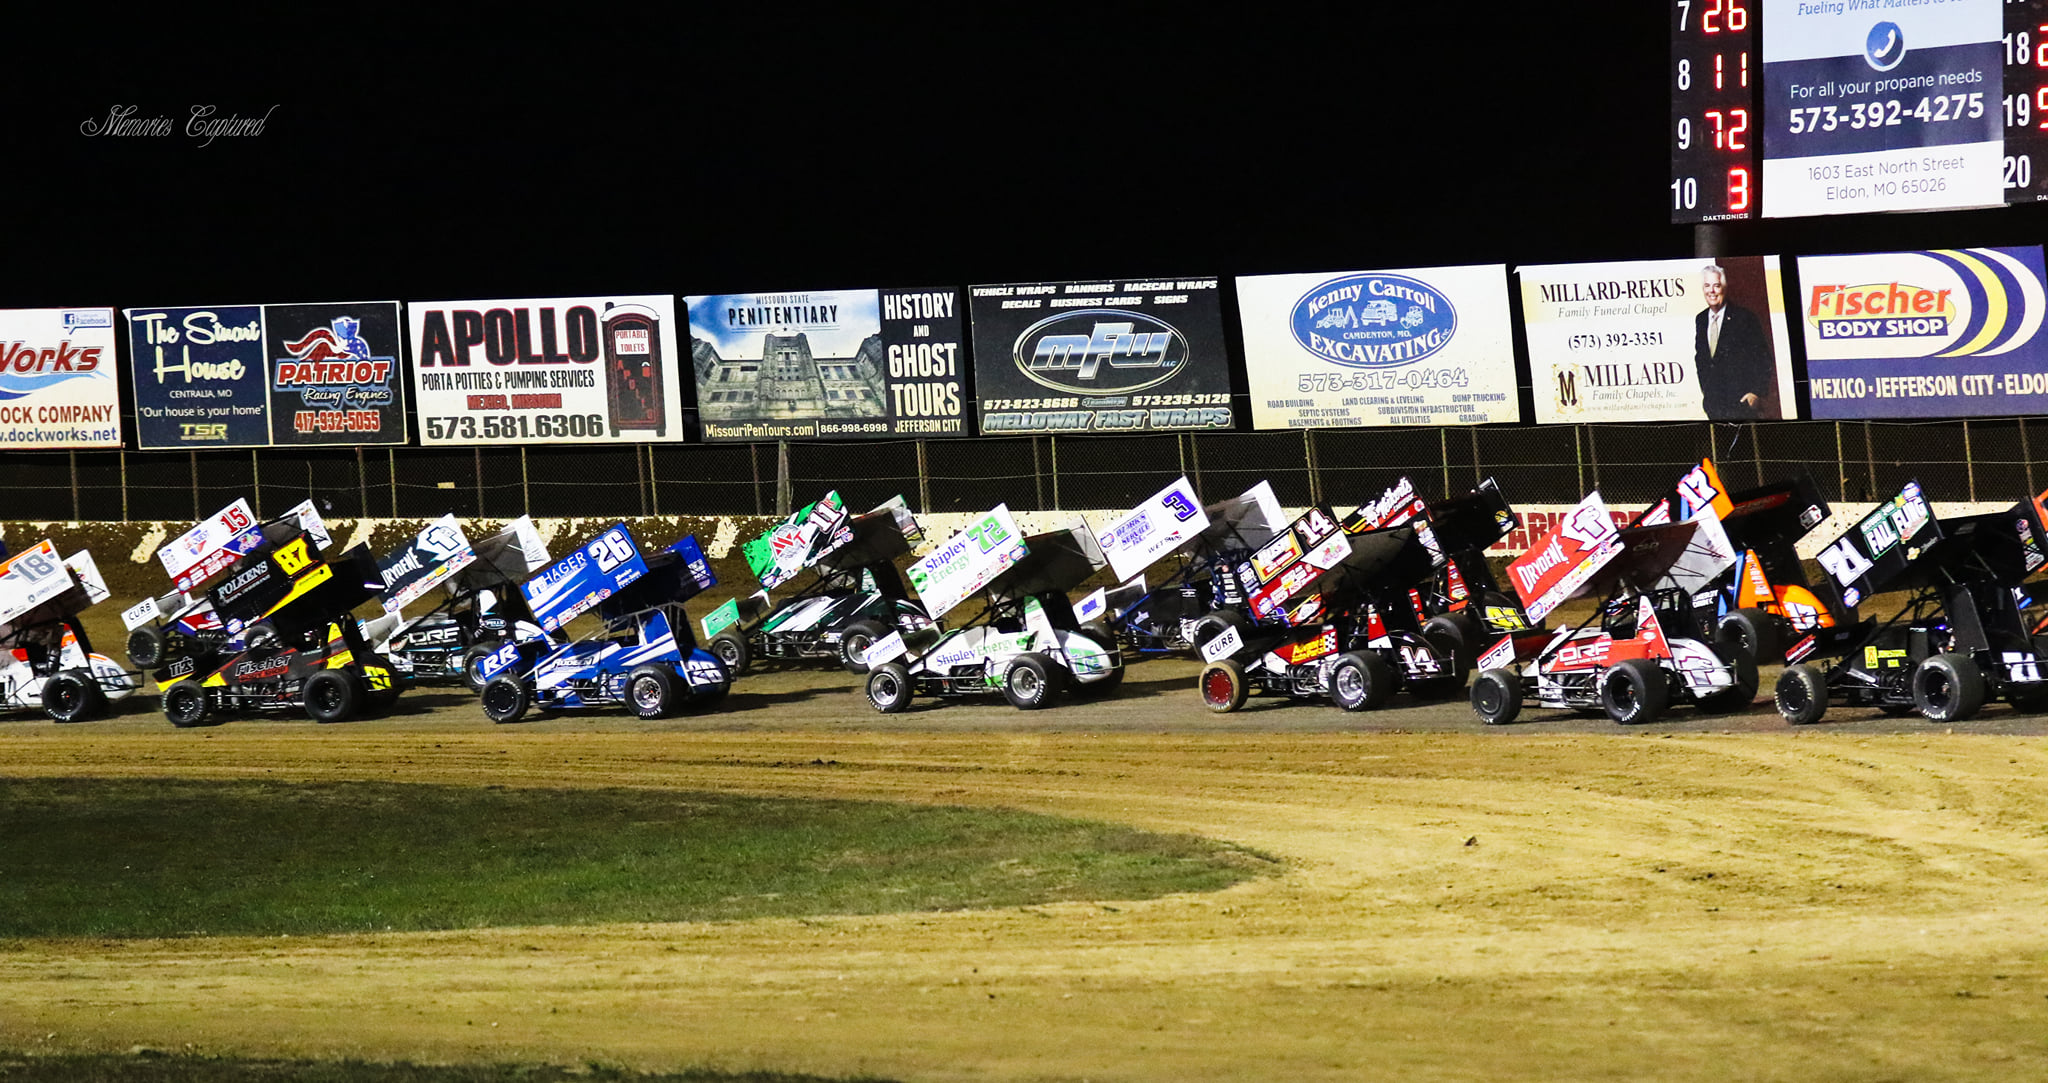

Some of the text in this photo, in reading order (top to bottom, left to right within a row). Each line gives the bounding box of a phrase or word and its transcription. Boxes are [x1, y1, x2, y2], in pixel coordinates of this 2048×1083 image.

[1678, 0, 1690, 31] 7
[1704, 0, 1747, 33] 26
[1798, 0, 1880, 15] Fueling What
[2002, 32, 2030, 65] 18
[1678, 59, 1690, 91] 8
[1716, 52, 1747, 89] 11
[1790, 69, 1982, 98] For all your propane needs
[1790, 92, 1984, 134] 573-392-4275
[2002, 93, 2030, 127] 19
[1678, 118, 1690, 150] 9
[1705, 109, 1748, 150] 72
[1808, 156, 1965, 180] 1603 East North Street
[2004, 154, 2031, 189] 20
[1671, 178, 1697, 210] 10
[1729, 168, 1748, 211] 3
[1826, 178, 1946, 201] Eldon, MO 65026
[1702, 213, 1749, 222] DAKTRONICS
[756, 294, 809, 304] MISSOURI STATE
[973, 280, 1218, 297] VEHICLE WRAPS BANNERS RACECAR WRAPS
[1308, 280, 1436, 318] Kenny Carroll
[1540, 278, 1685, 304] MILLARD-REKUS
[1810, 282, 1952, 317] Fischer
[728, 304, 838, 326] PENITENTIARY
[884, 292, 955, 320] HISTORY
[1002, 295, 1188, 310] DECALS BUSINESS CARDS SIGNS
[1558, 303, 1668, 320] Family Funeral Chapel
[132, 312, 260, 344] The Stuart
[420, 305, 600, 368] APOLLO
[616, 330, 648, 340] PORTABLE
[913, 324, 930, 338] AND
[1343, 330, 1412, 340] CAMDENTON, MO.
[1568, 332, 1664, 350] (573) 392-3351
[1822, 319, 1944, 338] BODY SHOP
[620, 343, 646, 354] TOILETS
[1310, 328, 1442, 362] EXCAVATING
[153, 345, 246, 384] House
[276, 360, 390, 386] PATRIOT
[888, 342, 958, 378] GHOST
[422, 369, 595, 391] PORTA POTTIES & PUMPING SERVICES
[1298, 366, 1469, 393] 573-317-0464
[1583, 361, 1684, 388] MILLARD
[1810, 374, 1994, 400] MEXICO JEFFERSON CITY
[218, 389, 232, 398] MO
[304, 387, 389, 406] Racing Engines
[467, 393, 562, 411] MEXICO, MISSOURI
[890, 382, 961, 417] TOURS
[984, 394, 1231, 410] 573-823-8686 573-239-3128
[1267, 400, 1284, 408] ROAD
[1286, 399, 1314, 408] BUILDING
[1342, 398, 1358, 406] LAND
[1360, 397, 1389, 406] CLEARING
[1396, 396, 1424, 404] LEVELING
[1452, 394, 1472, 402] DUMP
[1473, 393, 1506, 402] TRUCKING
[1592, 388, 1664, 402] Family Chapels,
[38, 404, 114, 424] COMPANY
[165, 406, 194, 416] house
[197, 406, 205, 416] is
[208, 408, 230, 418] your
[294, 410, 381, 433] 417-932-5055
[983, 408, 1232, 433] MELLOWAY FAST WRAPS
[1288, 414, 1488, 427] BASEMENTS FOOTINGS ALL UTILITIES GRADING
[1298, 404, 1474, 417] SEPTIC SYSTEMS SUBDIVISION INFRASTRUCTURE
[180, 424, 228, 437] TSR
[426, 414, 604, 440] 573.581.6306
[705, 423, 814, 438] MissouriPenTours.com
[820, 423, 888, 434] 866-998-6998
[894, 418, 962, 434] JEFFERSON CITY
[1676, 467, 1720, 512] 17
[1162, 488, 1198, 522] 3
[220, 506, 251, 536] 15
[1295, 507, 1340, 548] 14
[1866, 521, 1898, 556] FALL
[1890, 496, 1928, 537] FLING
[966, 516, 1011, 555] 72
[272, 537, 313, 577] 87
[589, 529, 636, 575] 26
[925, 539, 968, 573] Shipley
[1516, 534, 1570, 594] DRYDENE
[1816, 537, 1874, 588] 71
[14, 554, 55, 583] 18
[218, 560, 269, 597] FOLKENS
[544, 552, 586, 583] HAGER
[932, 552, 970, 585] Energy
[128, 602, 152, 621] CURB
[408, 627, 460, 644] DRF
[1208, 633, 1234, 657] CURB
[484, 643, 518, 675] RR
[936, 639, 1013, 668] Shipley Energy
[1400, 647, 1441, 674] 14
[1480, 640, 1512, 670] DRF
[1559, 642, 1612, 662] DRF
[235, 656, 292, 676] Fischer
